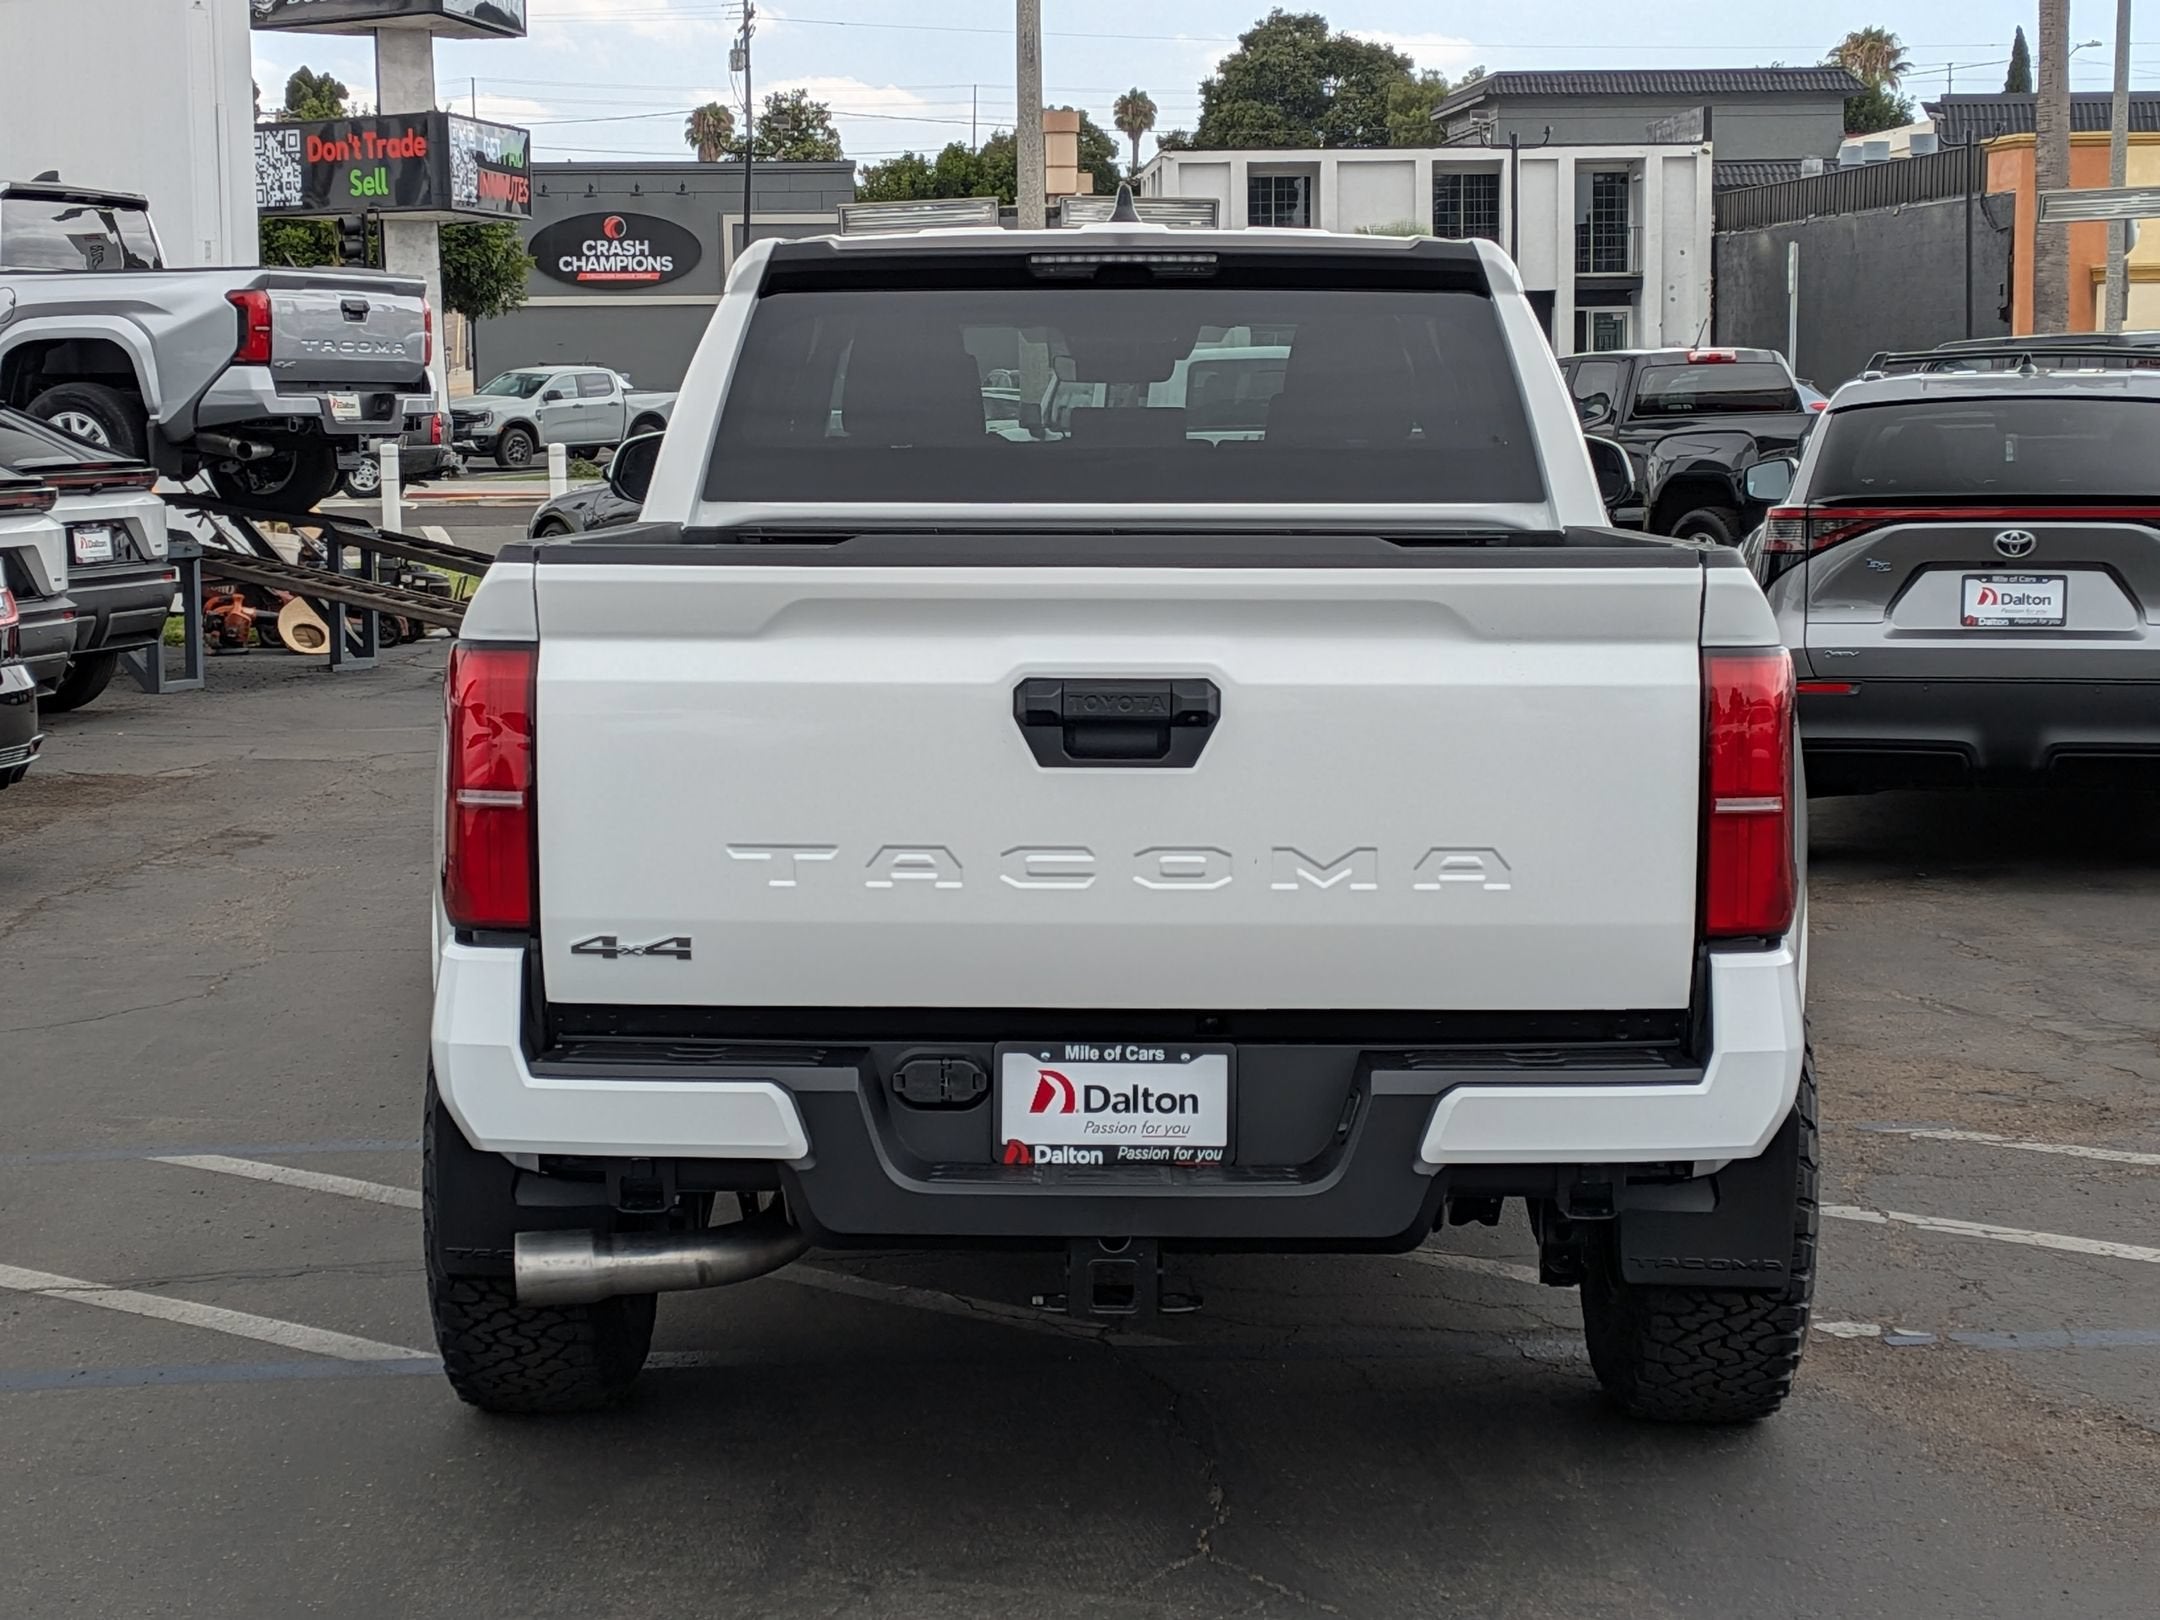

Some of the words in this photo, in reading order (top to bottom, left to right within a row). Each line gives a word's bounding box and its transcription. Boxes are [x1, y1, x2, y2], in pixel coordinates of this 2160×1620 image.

[306, 133, 361, 163] Don't
[363, 127, 427, 160] Trade
[350, 167, 389, 197] Sell
[582, 240, 649, 256] CRASH
[558, 256, 673, 272] CHAMPIONS
[300, 339, 406, 354] TACOMA
[2000, 593, 2052, 606] Dalton
[1067, 694, 1167, 713] TOYOTA
[724, 842, 1513, 891] TACOMA
[1065, 1045, 1099, 1061] Mile
[1103, 1045, 1122, 1061] of
[1125, 1045, 1165, 1061] Cars
[1083, 1084, 1199, 1114] Dalton
[1084, 1121, 1137, 1135] Passion
[1140, 1120, 1160, 1137] for
[1164, 1124, 1191, 1137] you
[1034, 1145, 1103, 1165] Dalton
[1117, 1146, 1169, 1160] Passion
[1174, 1146, 1195, 1162] for
[1196, 1150, 1223, 1163] you
[1628, 1257, 1784, 1272] TACOMA
